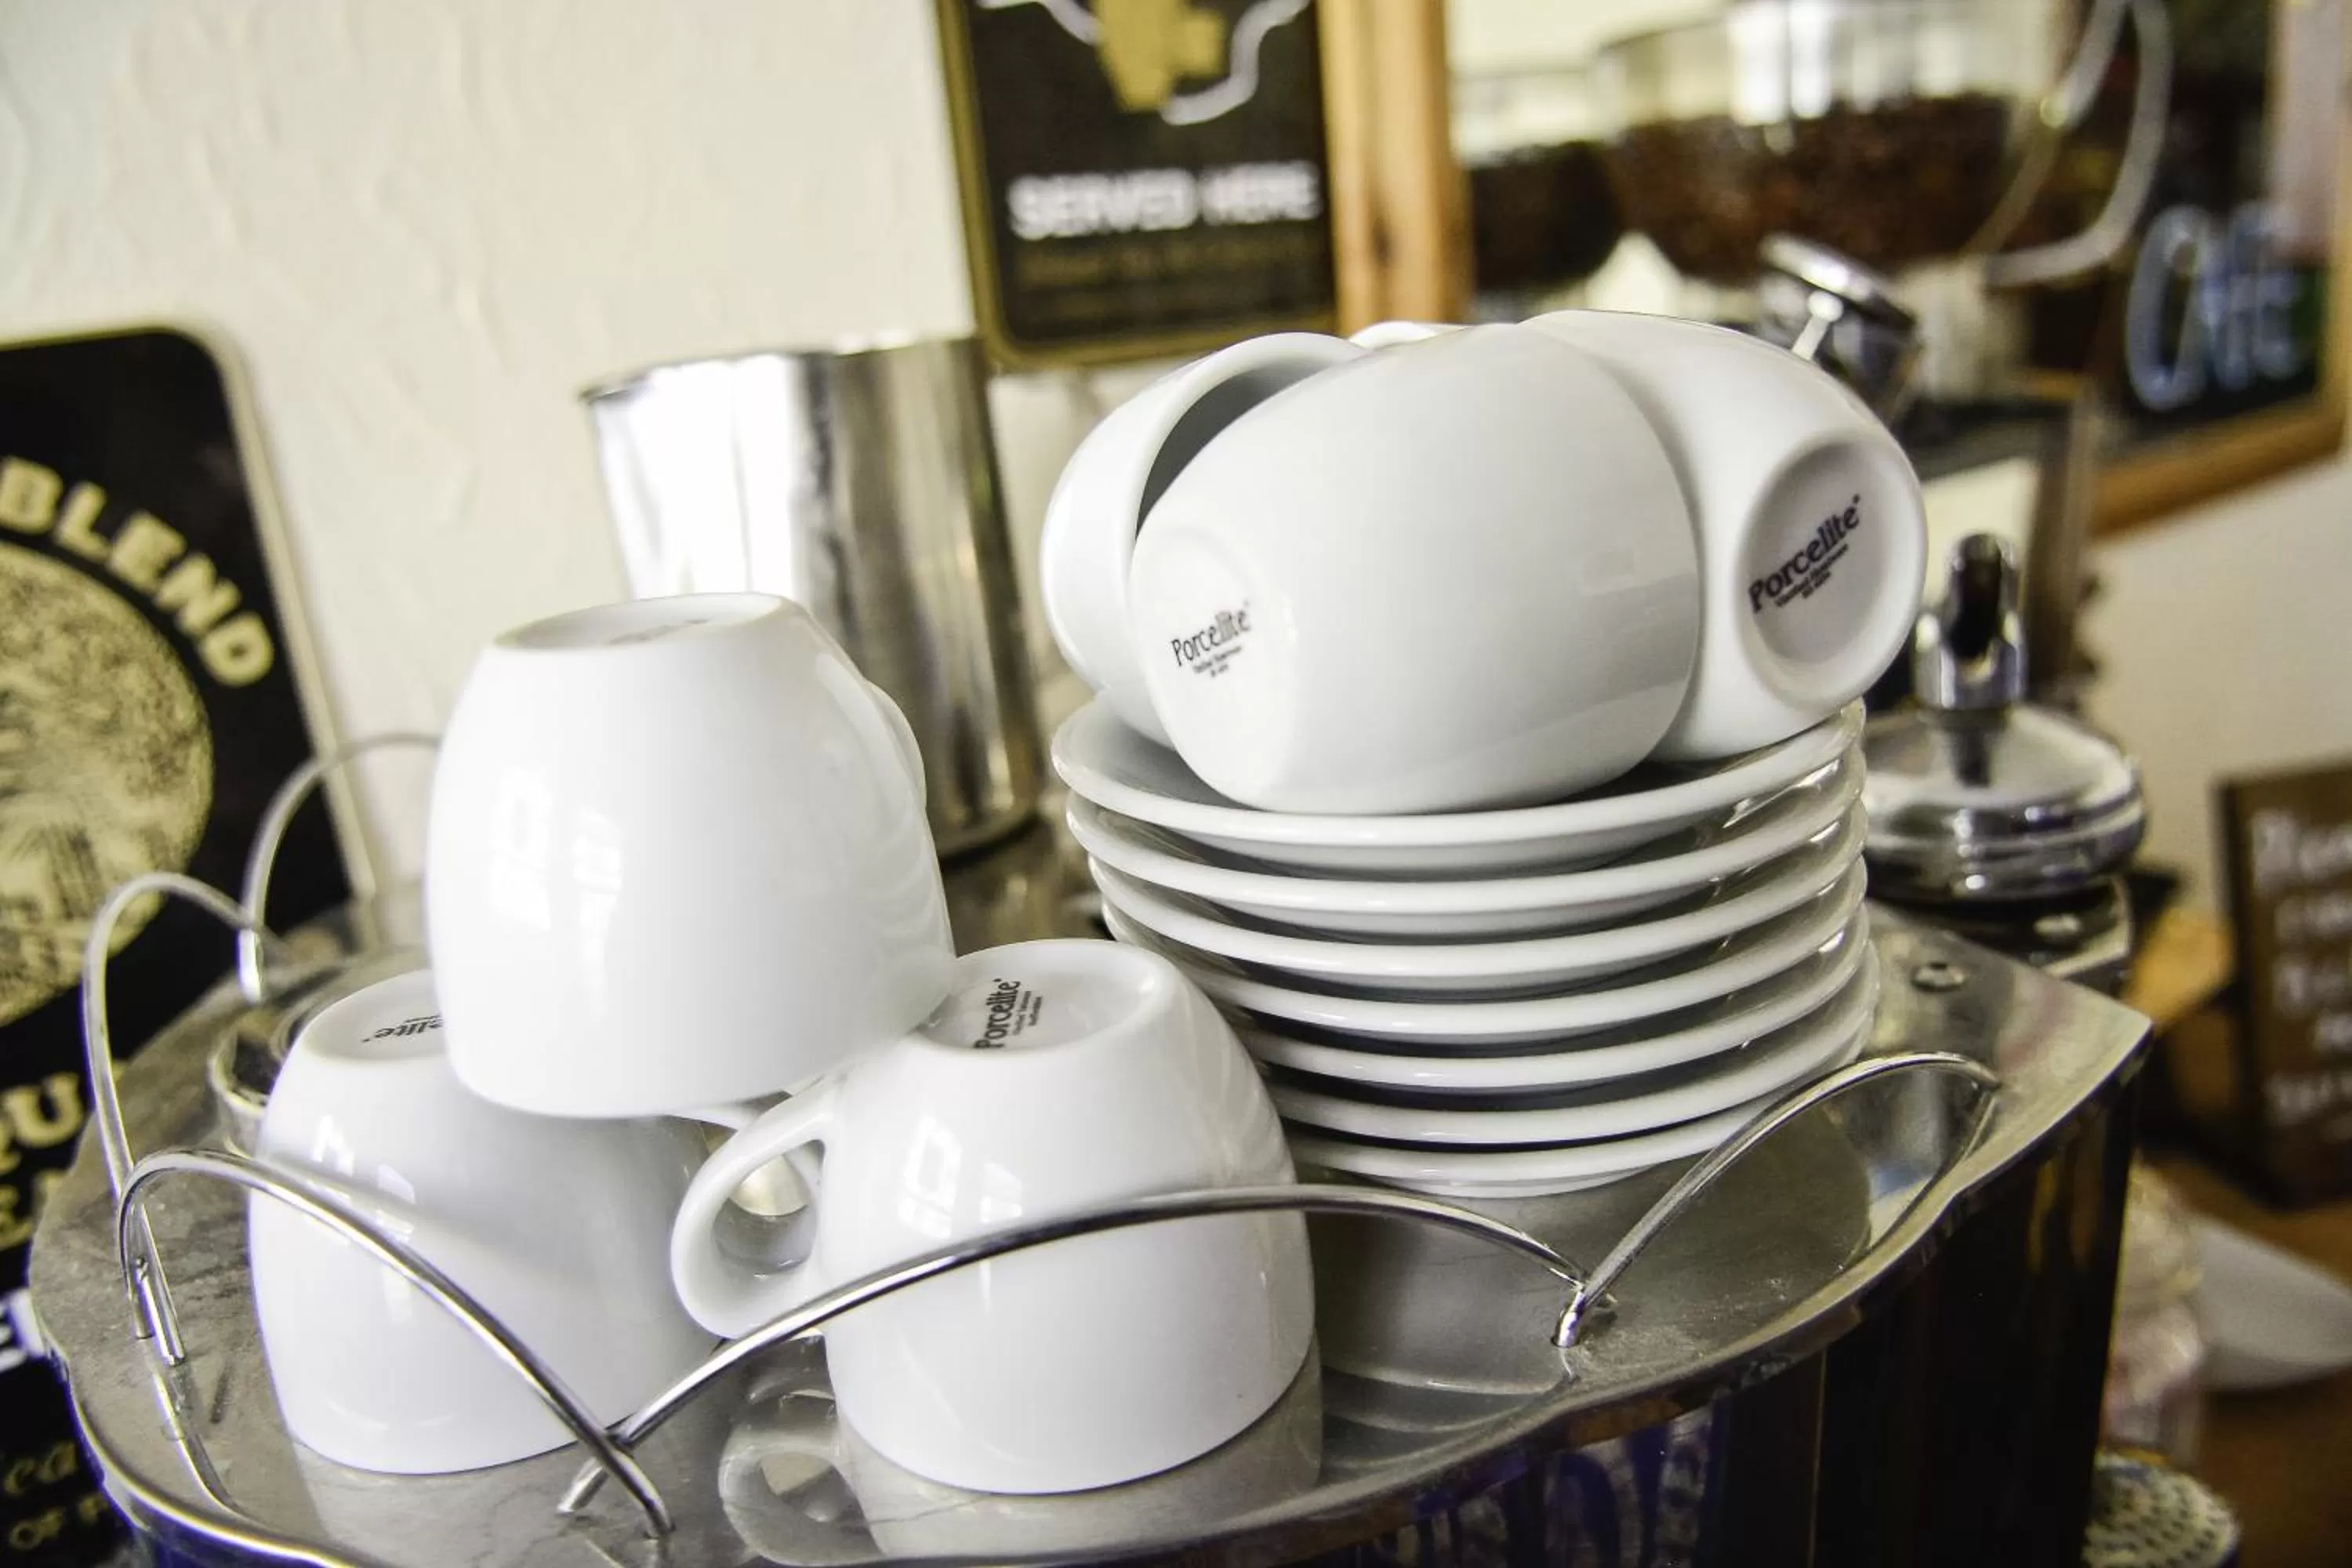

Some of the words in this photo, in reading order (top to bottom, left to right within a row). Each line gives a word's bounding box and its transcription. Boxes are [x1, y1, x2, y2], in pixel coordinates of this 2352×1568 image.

[1007, 168, 1200, 241] SERVED
[0, 456, 274, 687] BLEND
[1748, 506, 1860, 614] Porcelite
[973, 981, 1021, 1049] Porcelite
